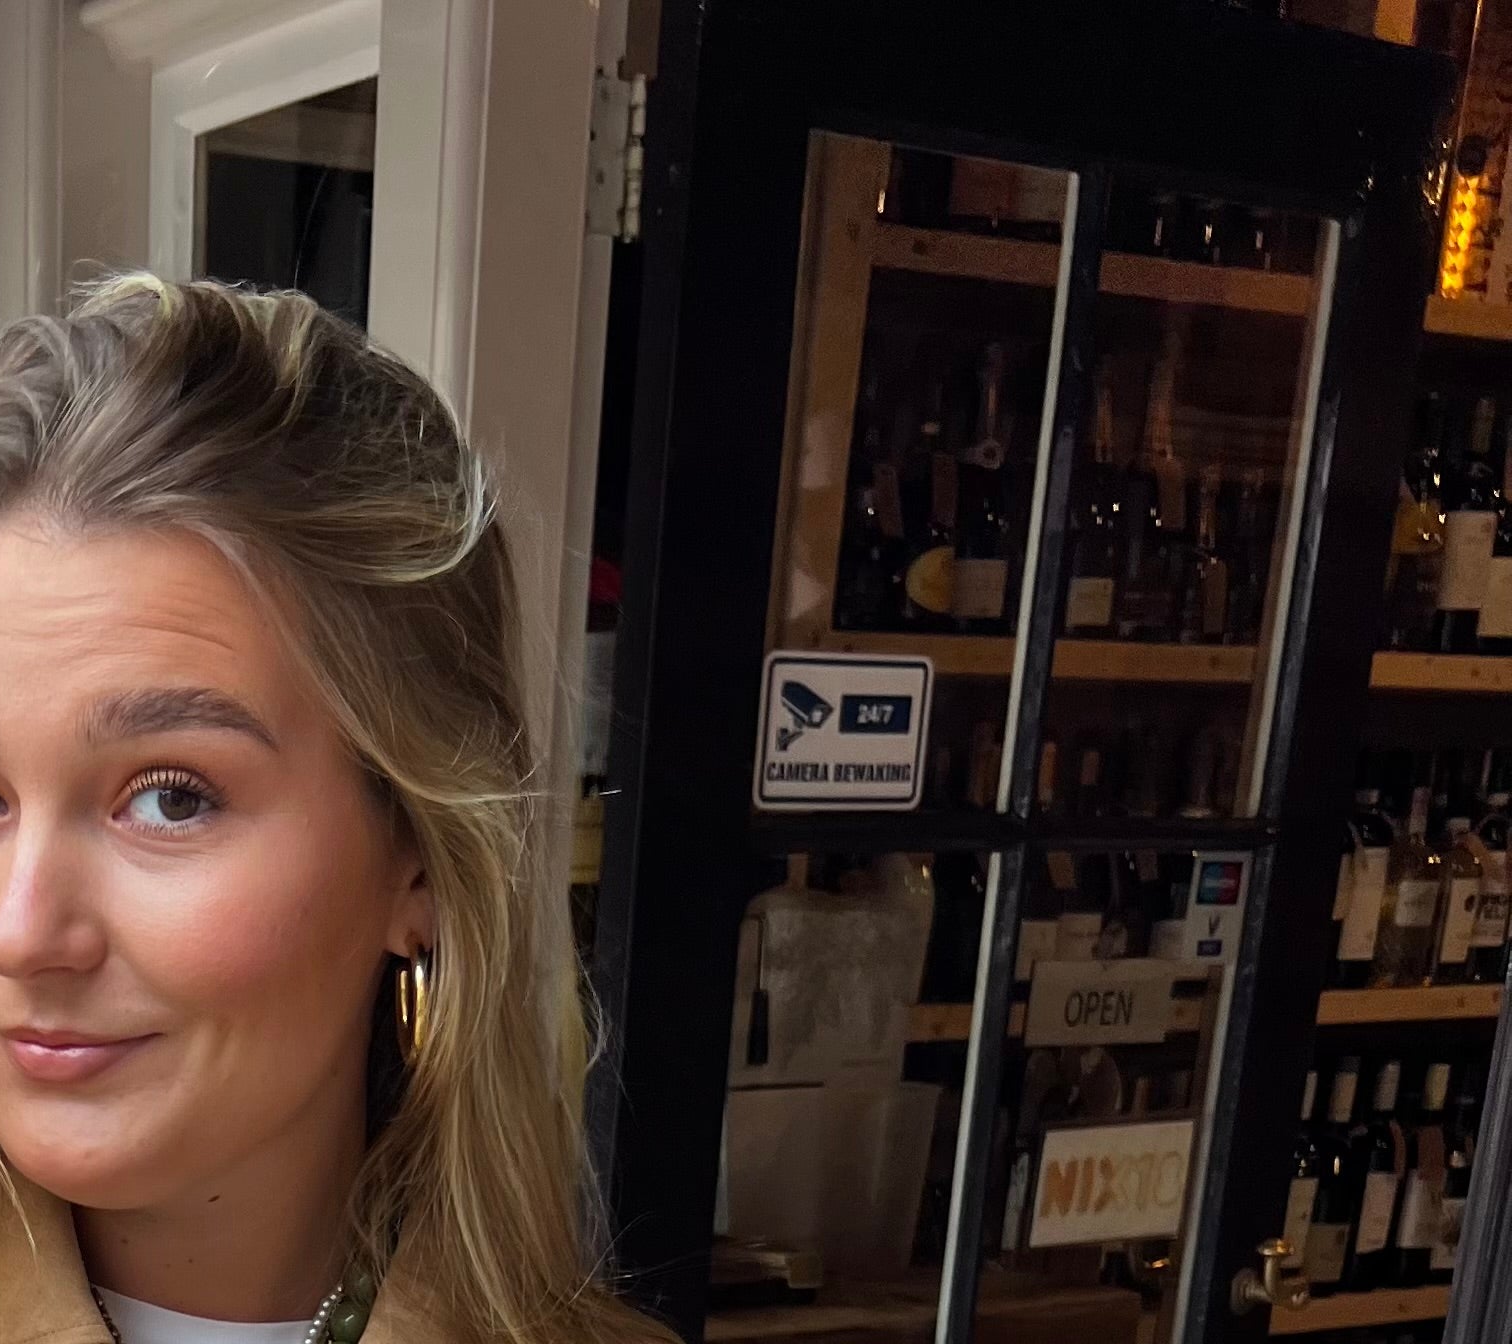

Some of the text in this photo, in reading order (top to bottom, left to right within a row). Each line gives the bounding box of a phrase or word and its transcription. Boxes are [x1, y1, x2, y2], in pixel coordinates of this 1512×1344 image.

[857, 704, 894, 724] 24/7
[766, 762, 911, 783] CAMERA BEWAKING
[1064, 990, 1133, 1028] OPEN
